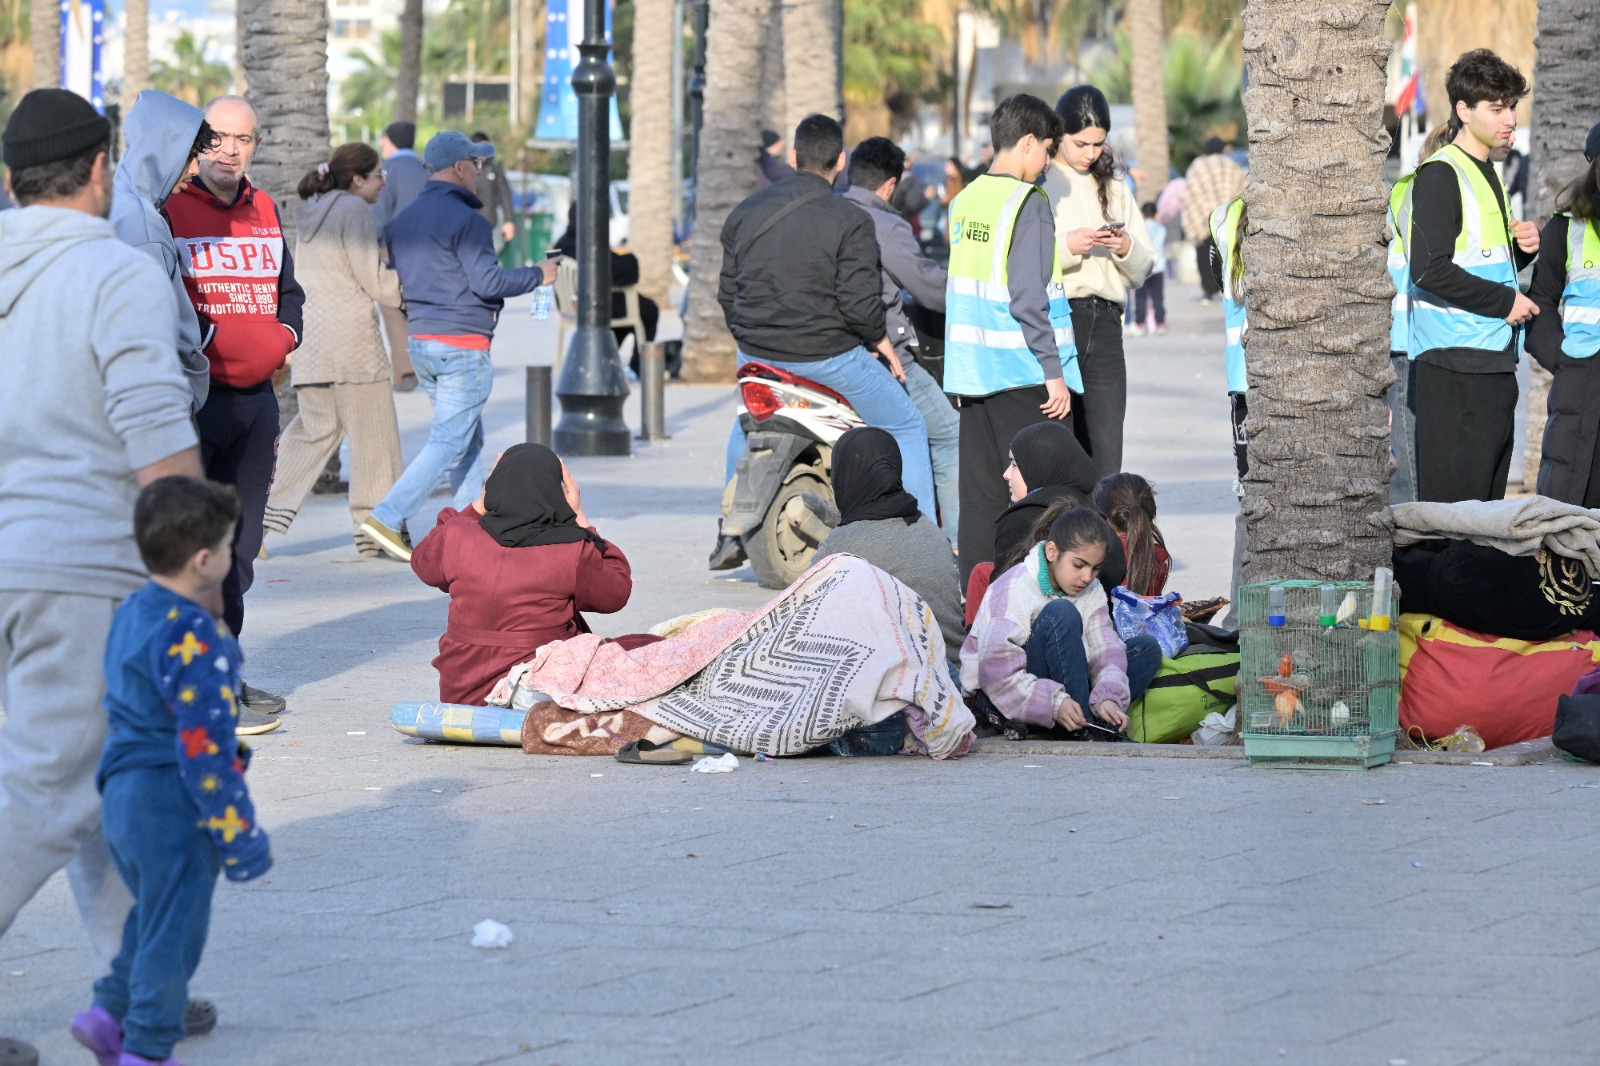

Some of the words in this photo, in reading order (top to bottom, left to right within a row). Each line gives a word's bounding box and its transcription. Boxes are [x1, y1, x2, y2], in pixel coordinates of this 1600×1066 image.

[966, 229, 990, 242] NEED
[187, 241, 278, 272] USPA
[198, 282, 251, 294] AUTHENTIC
[252, 282, 277, 294] DENIM
[229, 292, 253, 304] SINCE
[197, 302, 247, 315] TRADITION
[248, 303, 258, 315] OF
